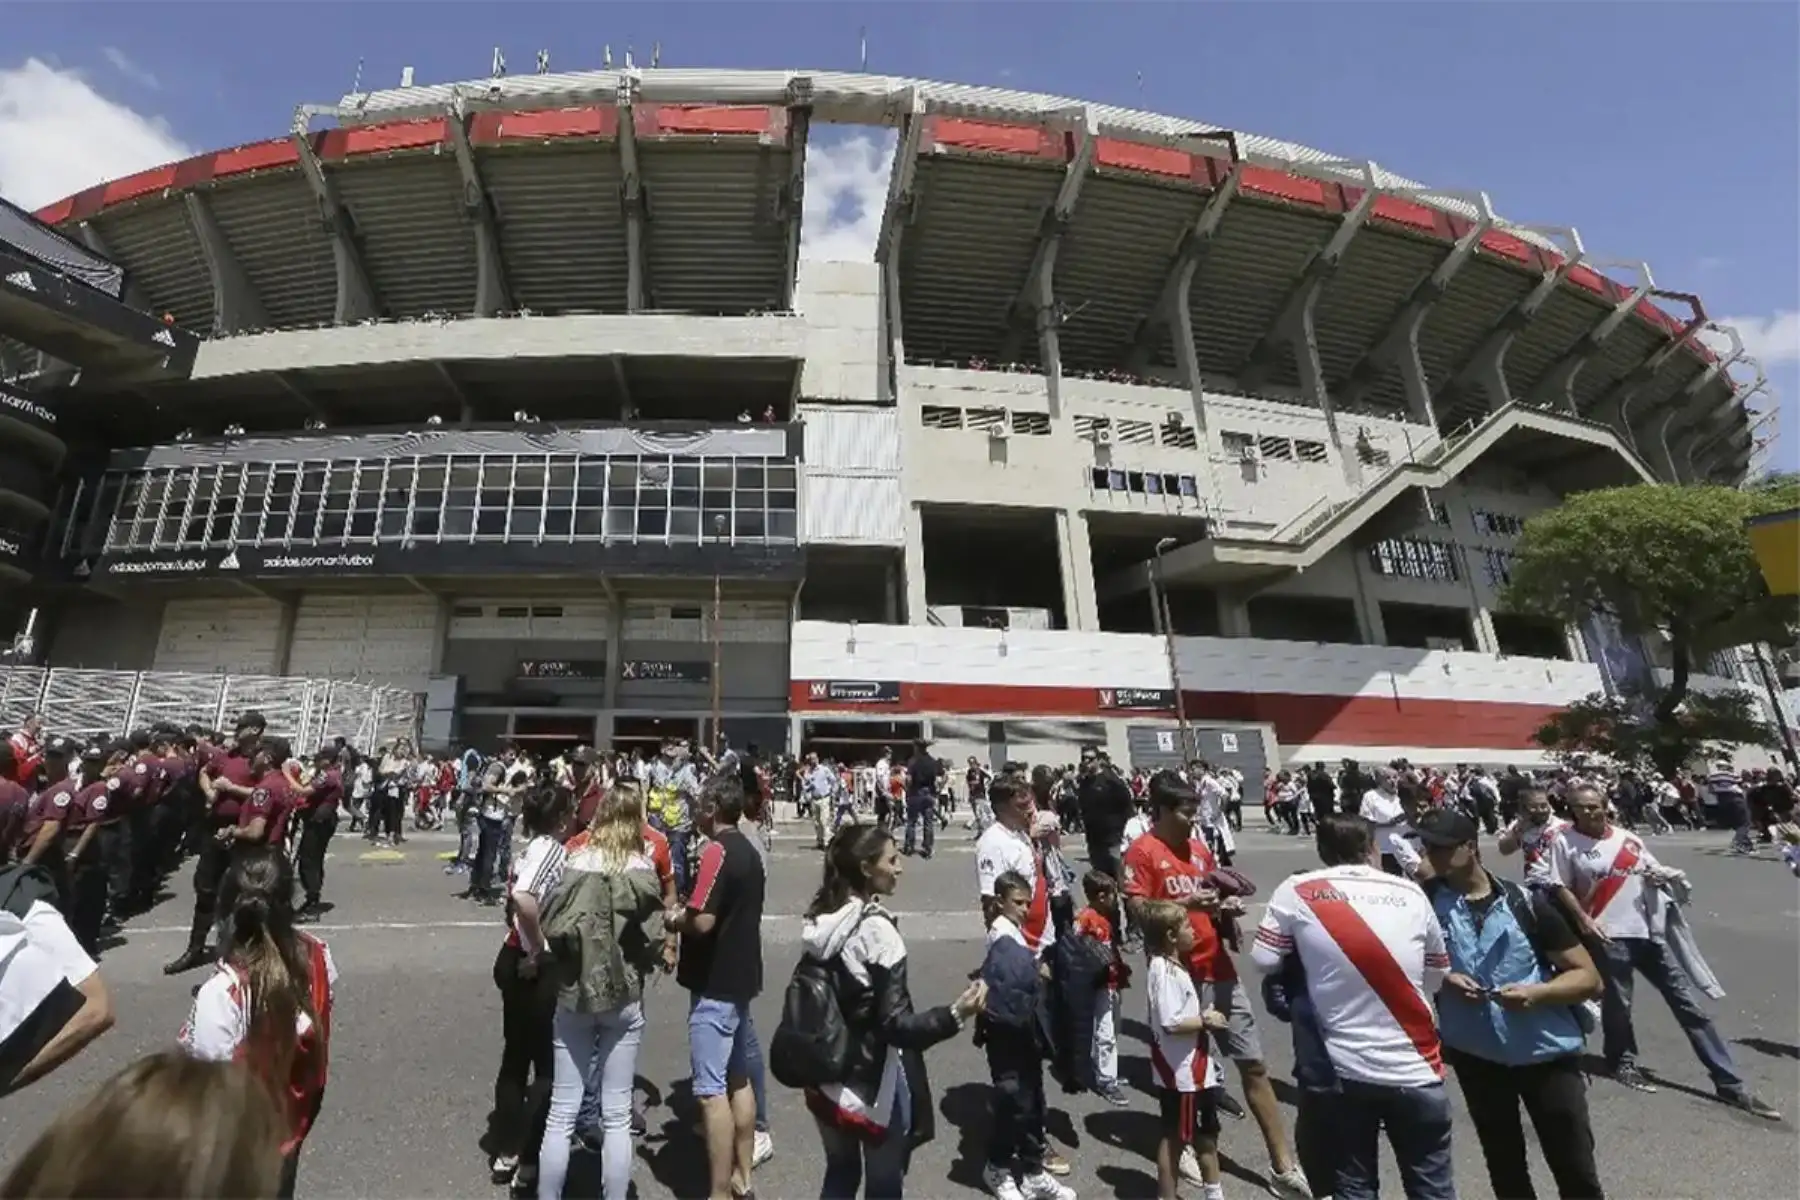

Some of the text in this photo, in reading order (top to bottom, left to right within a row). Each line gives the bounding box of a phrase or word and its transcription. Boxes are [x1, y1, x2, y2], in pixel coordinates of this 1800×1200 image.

[522, 662, 534, 676] Y
[622, 661, 637, 678] X
[810, 683, 827, 696] W
[1100, 689, 1111, 705] V
